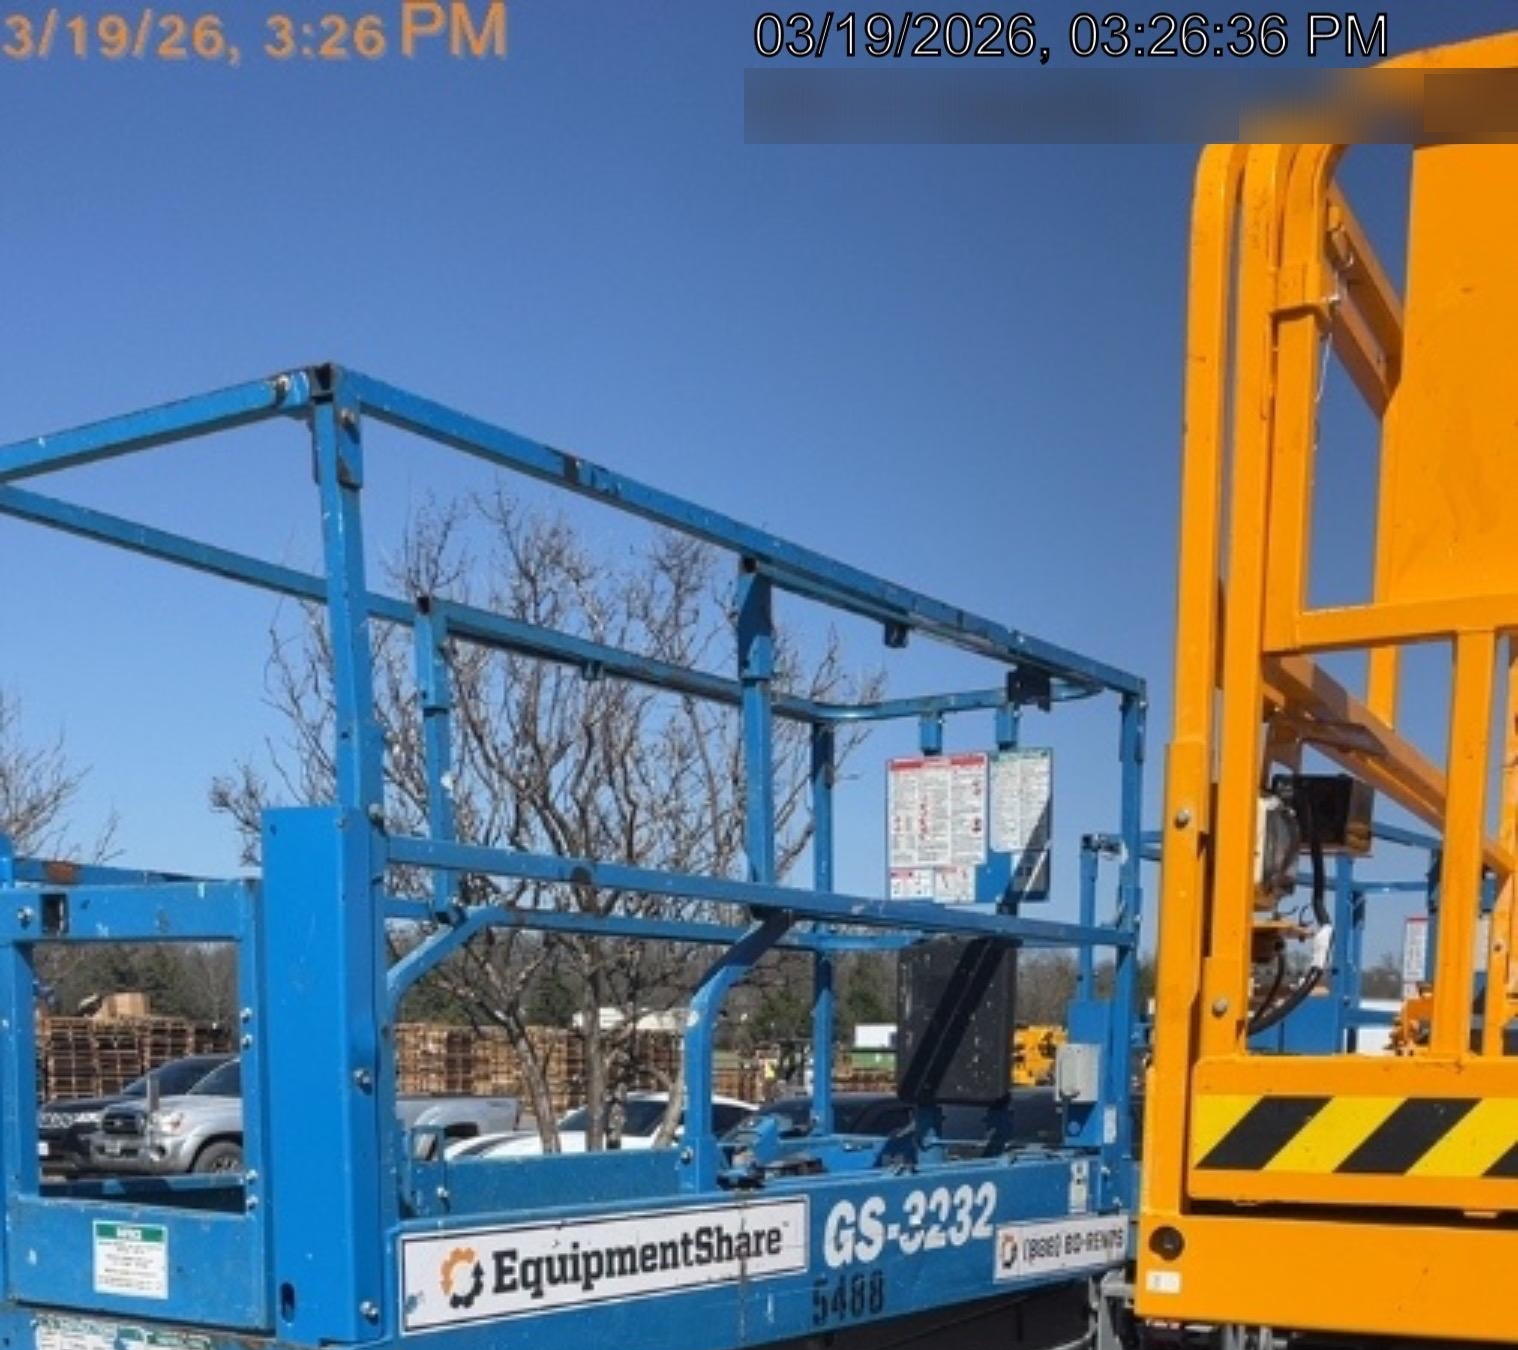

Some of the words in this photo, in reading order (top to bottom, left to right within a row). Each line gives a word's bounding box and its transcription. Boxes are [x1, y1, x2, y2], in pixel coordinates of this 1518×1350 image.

[823, 1181, 998, 1268] GS-3232
[491, 1226, 784, 1300] EquipmentShare
[811, 1269, 885, 1326] 5488
